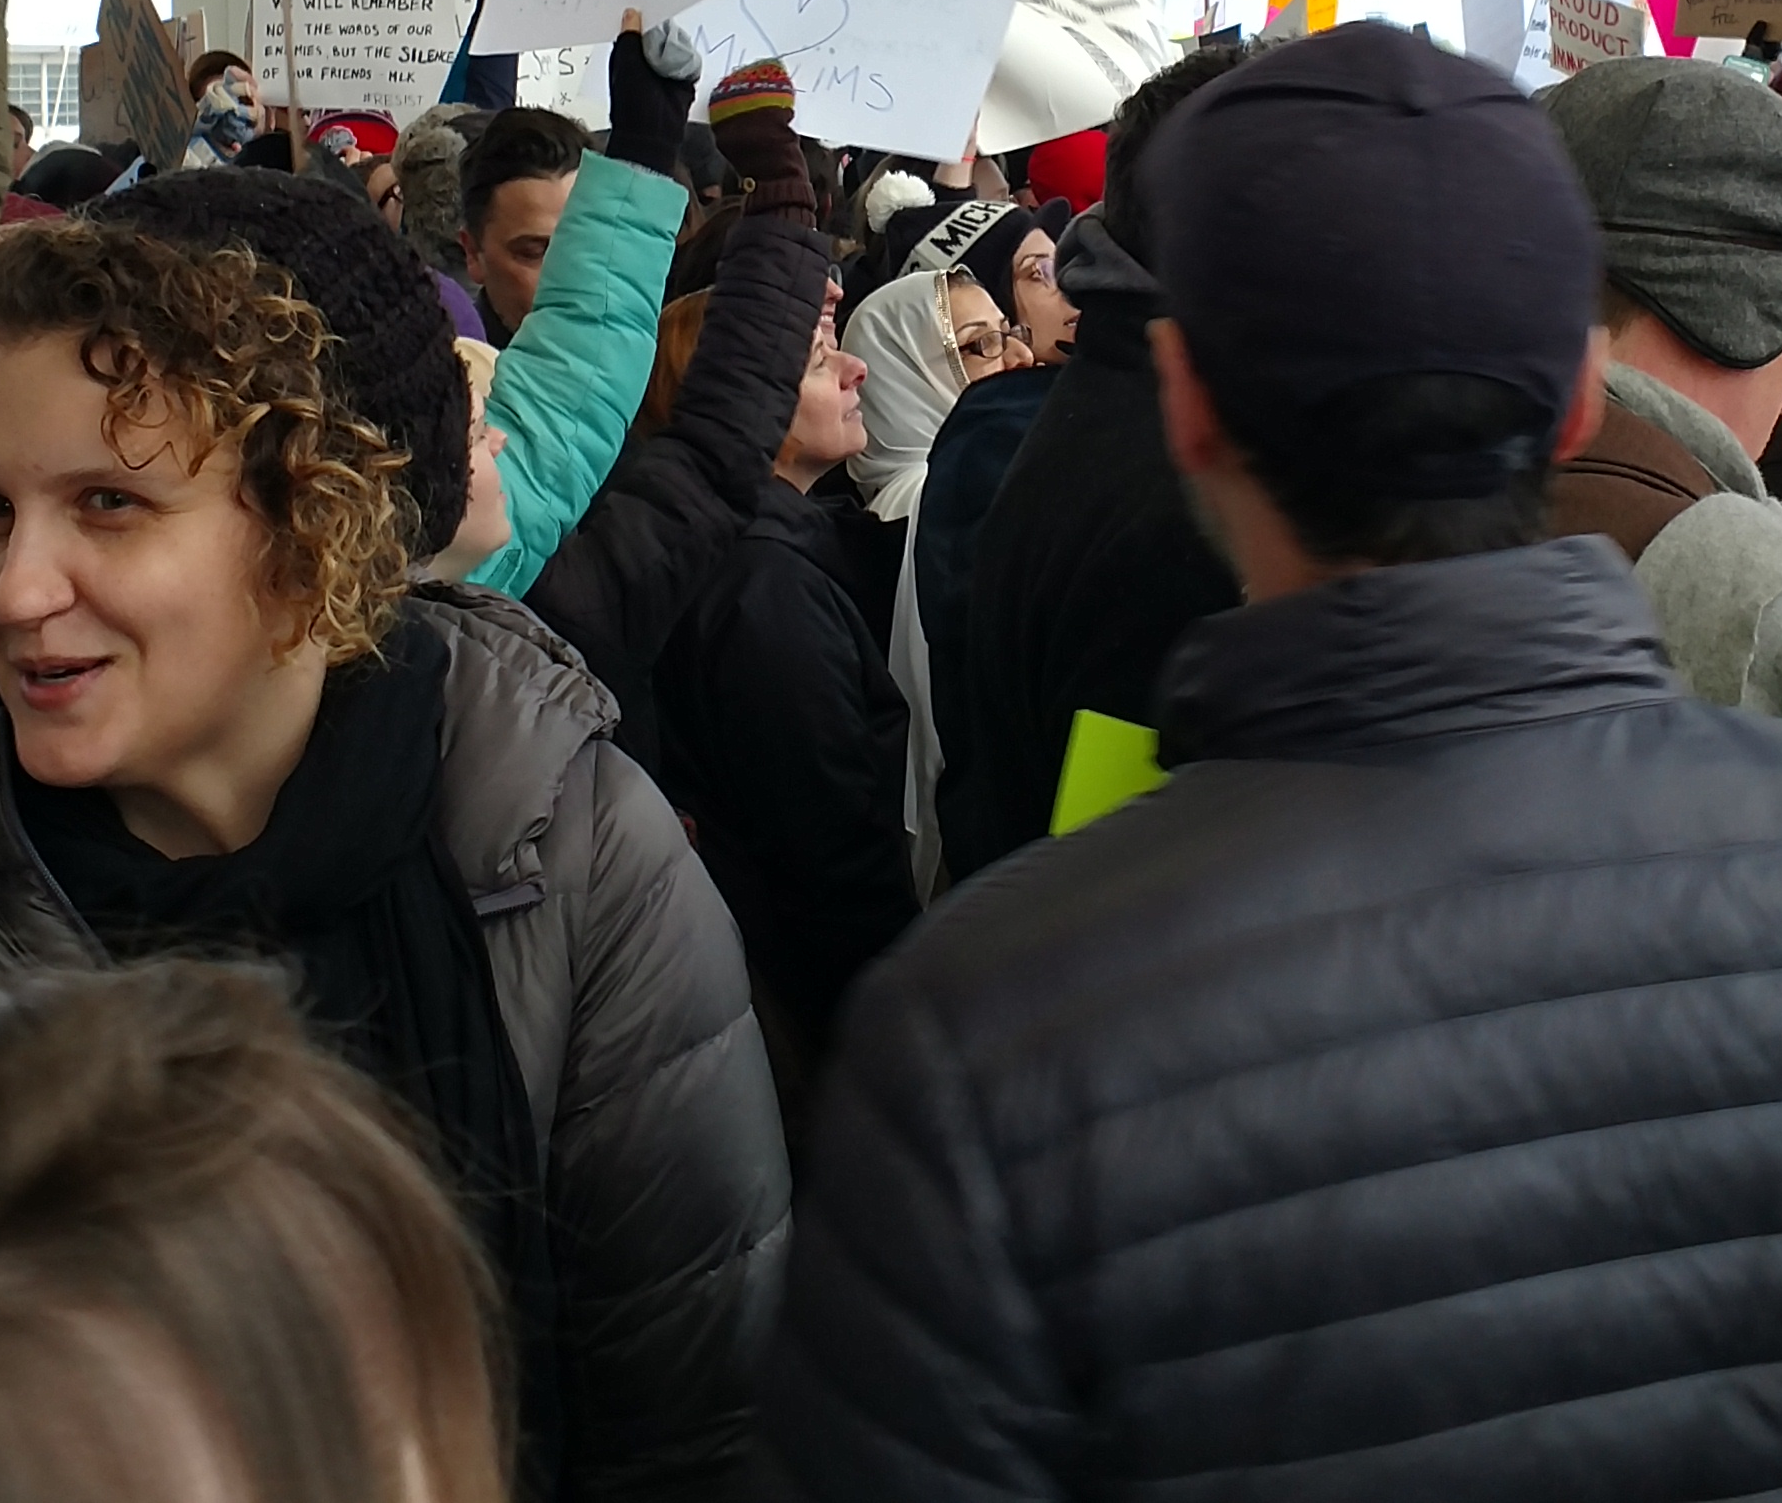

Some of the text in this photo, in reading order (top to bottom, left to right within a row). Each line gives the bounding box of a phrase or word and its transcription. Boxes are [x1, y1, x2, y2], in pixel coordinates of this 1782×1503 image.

[304, 23, 333, 36] THE
[339, 23, 380, 37] WORDS
[387, 23, 401, 35] OF
[407, 23, 432, 36] OUR
[1549, 6, 1629, 56] PRODUCT
[332, 45, 356, 58] BUT
[364, 46, 391, 59] THE
[398, 46, 455, 64] SILENCE
[262, 68, 280, 79] OF
[321, 67, 372, 80] FRIENDS
[363, 93, 424, 106] #RESIST
